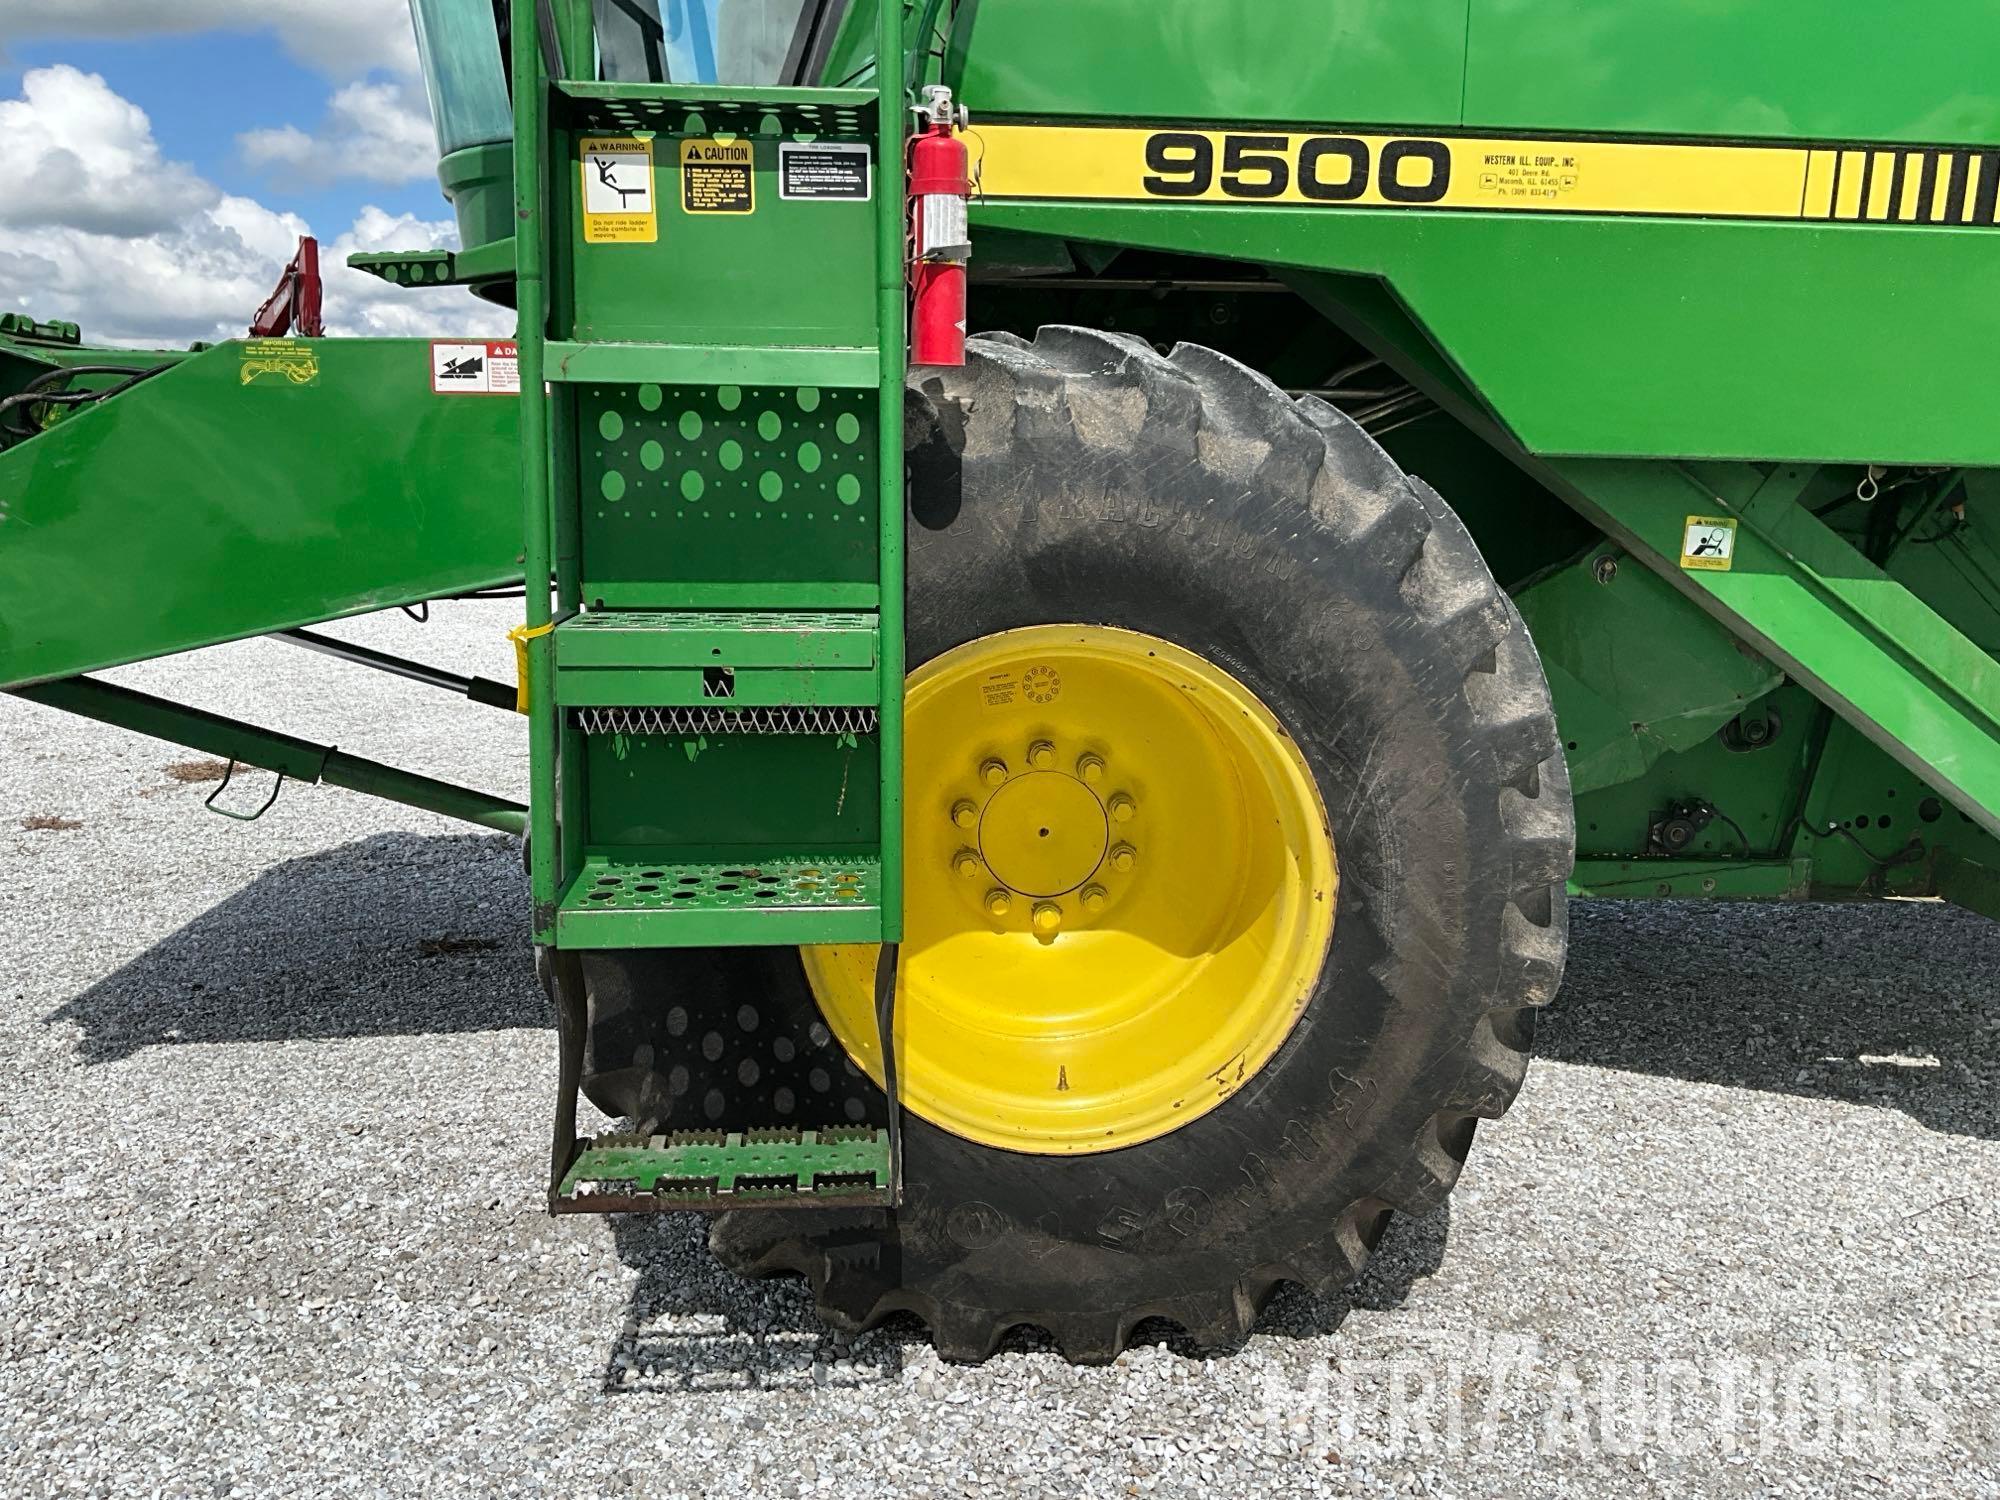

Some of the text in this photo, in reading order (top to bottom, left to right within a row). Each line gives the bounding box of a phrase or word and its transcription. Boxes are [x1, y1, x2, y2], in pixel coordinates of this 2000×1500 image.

[599, 142, 645, 151] WARNING
[704, 147, 748, 161] CAUTION
[1484, 154, 1516, 165] WESTERN
[1143, 132, 1452, 204] 9500
